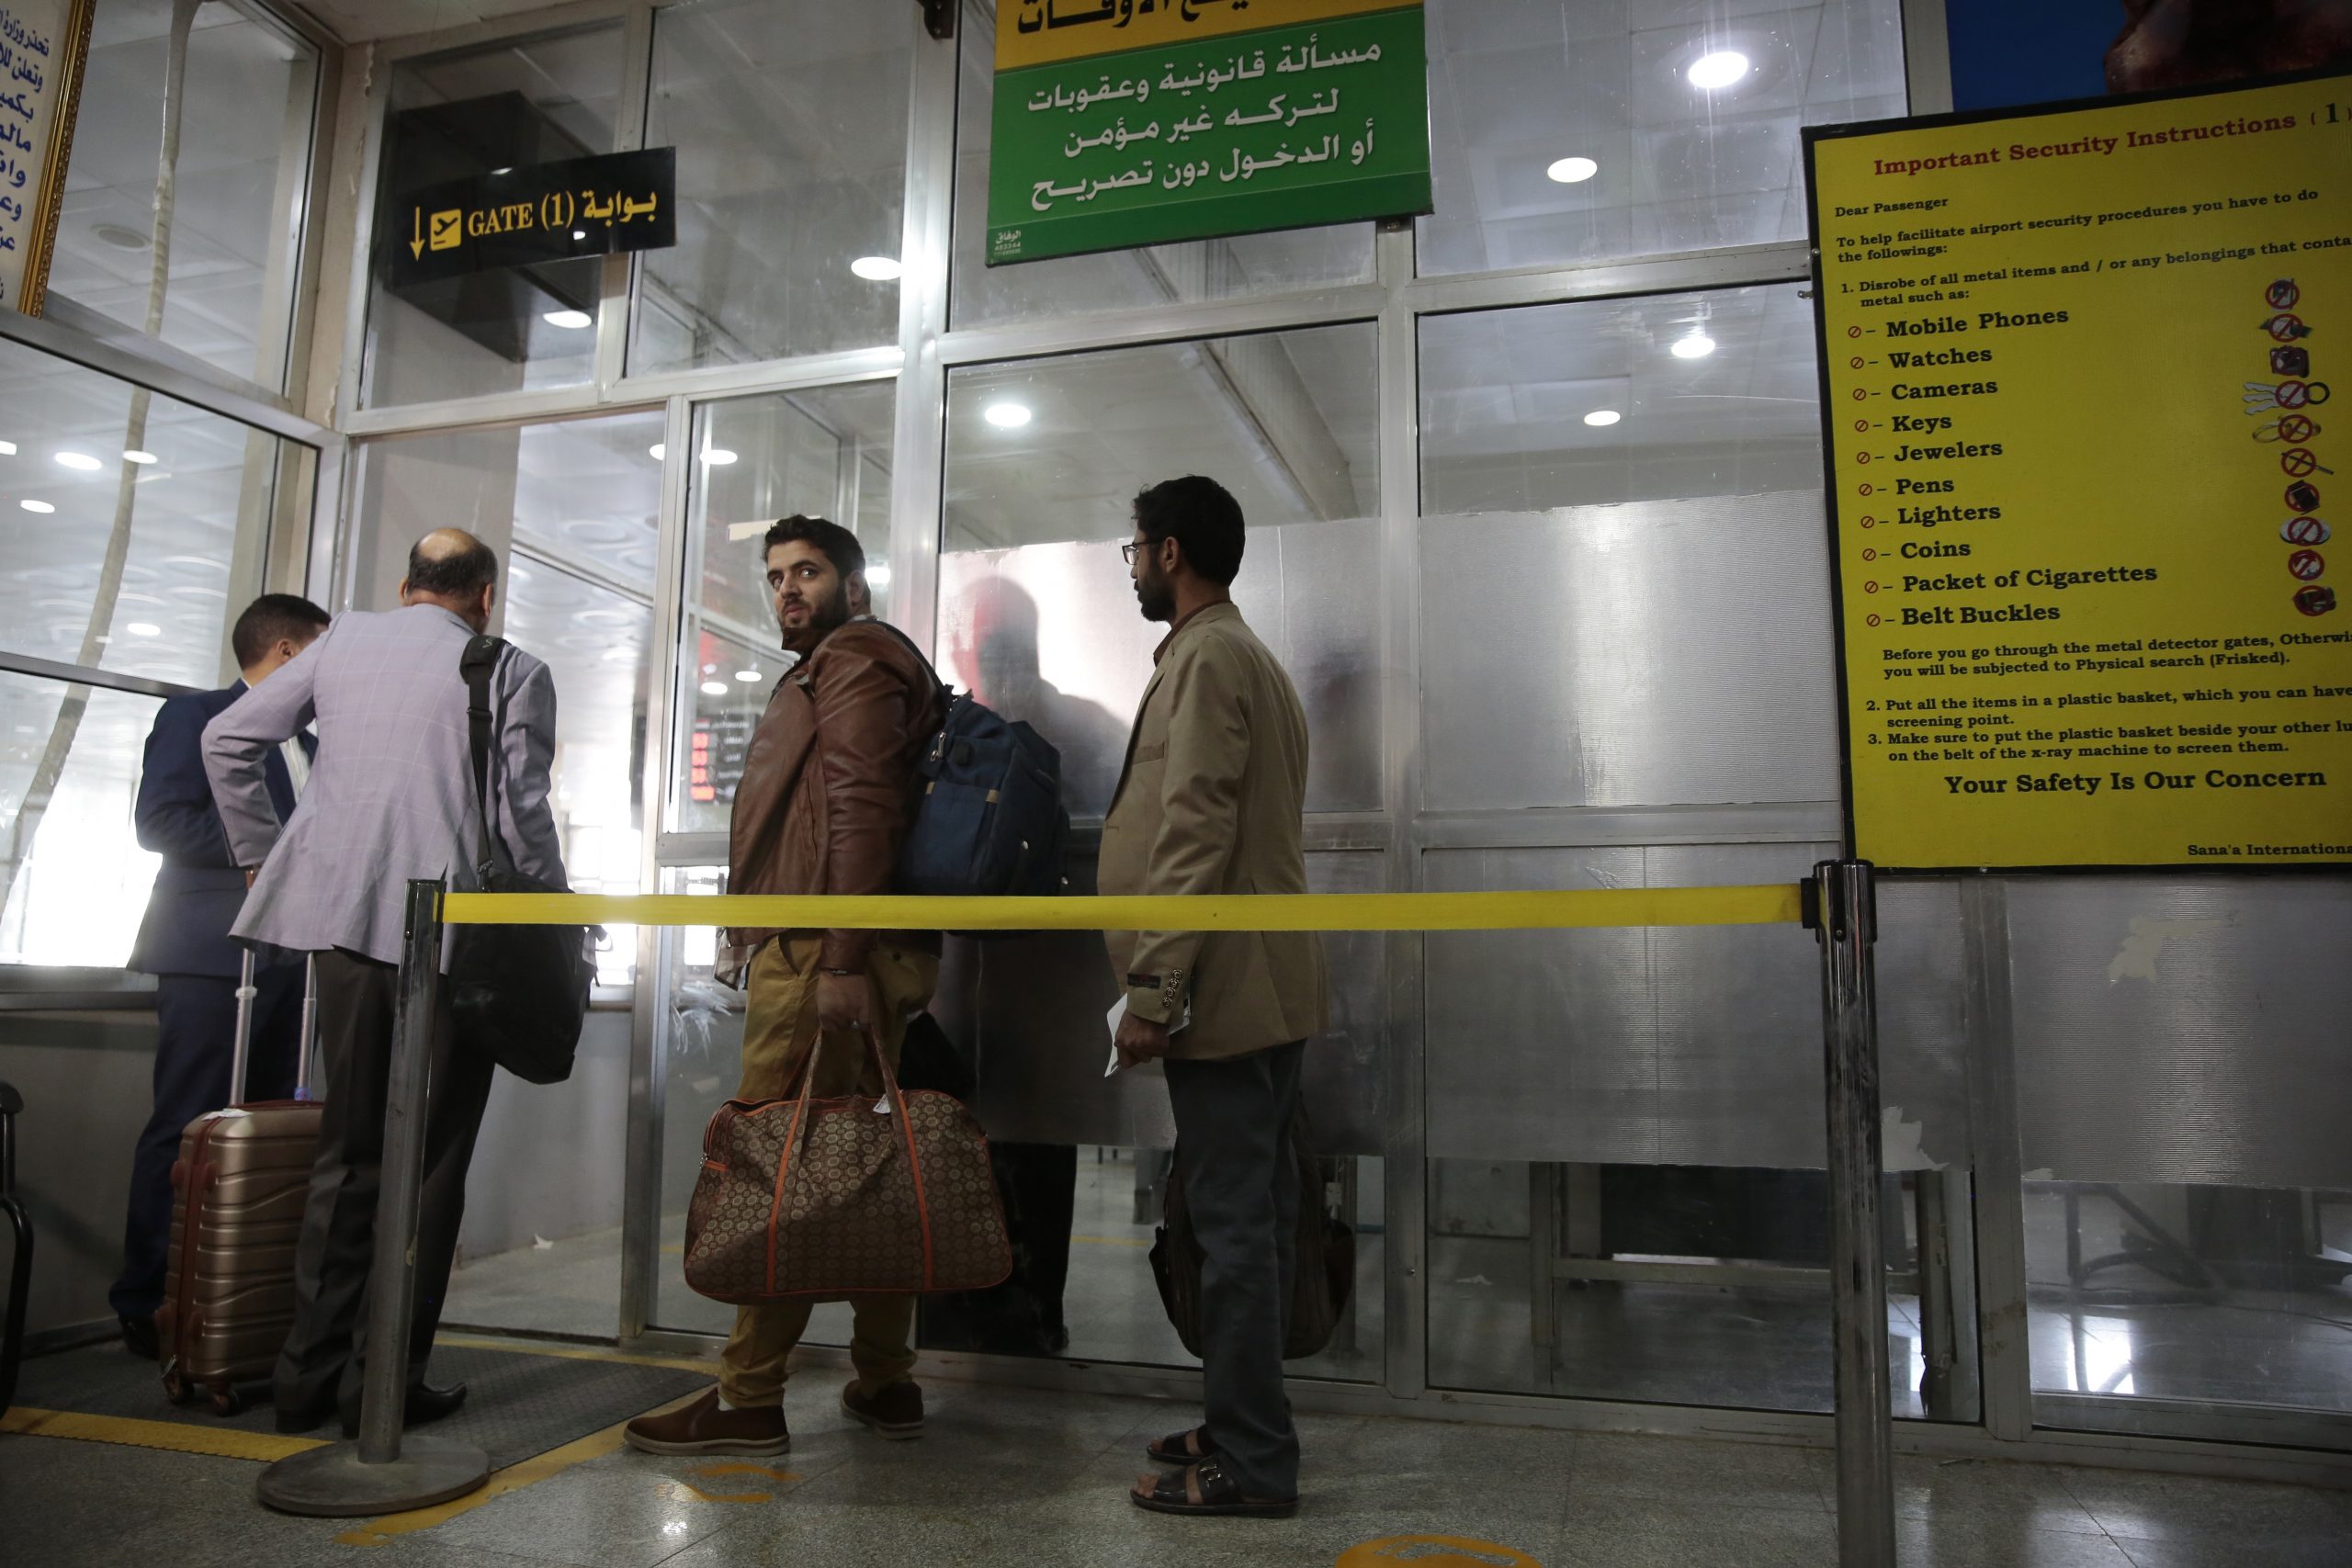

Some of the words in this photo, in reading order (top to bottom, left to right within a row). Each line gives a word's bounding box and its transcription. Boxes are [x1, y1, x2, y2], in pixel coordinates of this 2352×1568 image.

[1275, 32, 1383, 73] مسألة
[1158, 49, 1266, 96] قانونية
[1027, 74, 1150, 113] وعقوبات
[1224, 87, 1340, 127] لتركه
[1166, 104, 1215, 143] غير
[1063, 117, 1161, 158] مؤمن
[1350, 118, 1375, 164] أو
[1873, 147, 2001, 176] Important
[2008, 136, 2119, 161] Security
[2126, 116, 2297, 148] Instructions
[1219, 134, 1340, 183] الدخول
[1031, 159, 1154, 211] تصريح
[1161, 159, 1210, 190] دون
[468, 202, 534, 237] GATE
[540, 191, 576, 231] (1)
[582, 189, 659, 228] بوابة
[1834, 206, 1870, 218] Dear
[1872, 197, 1949, 214] Passenger
[1836, 236, 1856, 248] To
[1859, 232, 1893, 246] help
[1896, 227, 1966, 242] facilitate
[1970, 220, 2024, 236] airport
[2027, 214, 2093, 230] security
[2097, 205, 2188, 226] procedures
[2191, 201, 2223, 216] you
[2227, 197, 2268, 209] have
[2273, 193, 2292, 204] to
[2297, 188, 2319, 201] do
[1837, 252, 1862, 264] the
[1867, 245, 1948, 261] followings:
[1840, 282, 1855, 294] 1.
[1859, 277, 1916, 292] Disrobe
[1920, 274, 1938, 287] of
[1939, 272, 1960, 285] all
[1962, 268, 2008, 283] metal
[2011, 266, 2057, 279] items
[2060, 260, 2091, 275] and
[2109, 260, 2128, 270] or
[2131, 256, 2162, 269] any
[2165, 247, 2256, 265] belongings
[2259, 241, 2298, 255] that
[1860, 293, 1905, 308] metal
[1907, 289, 1944, 303] such
[1948, 289, 1970, 300] as:
[1885, 315, 1968, 338] Mobile
[1977, 310, 2070, 330] Phones
[1887, 347, 1993, 369] Watches
[1891, 381, 1999, 400] Cameras
[1891, 414, 1952, 435] Keys
[1893, 440, 2004, 462] Jewelers
[1894, 478, 1955, 496] Pens
[1896, 504, 2002, 528] Lighters
[1900, 540, 1972, 559] Coins
[1902, 572, 1987, 592] Packet
[1994, 570, 2021, 588] of
[2026, 566, 2158, 591] Cigarettes
[1900, 605, 1955, 626] Belt
[1959, 603, 2062, 624] Buckles
[1882, 648, 1933, 660] Before
[1937, 649, 1967, 662] you
[1971, 648, 1990, 661] go
[1994, 642, 2059, 658] through
[2063, 641, 2091, 654] the
[2095, 638, 2143, 653] metal
[2147, 637, 2219, 651] detector
[2223, 636, 2275, 651] gates,
[1883, 668, 1914, 681] you
[1917, 663, 1946, 677] will
[1949, 663, 1968, 675] be
[1973, 660, 2050, 677] subjected
[2052, 660, 2071, 671] to
[2075, 656, 2145, 673] Physical
[2149, 654, 2206, 668] search
[2210, 650, 2290, 669] (Frisked).
[1865, 699, 1881, 712] 2.
[1884, 699, 1914, 711] Put
[1917, 697, 1938, 710] all
[1940, 697, 1968, 710] the
[1972, 696, 2018, 709] items
[2021, 694, 2040, 707] in
[2042, 696, 2053, 706] a
[2057, 692, 2113, 709] plastic
[2116, 691, 2178, 705] basket,
[2181, 688, 2234, 702] which
[2238, 690, 2272, 704] you
[2276, 688, 2309, 699] can
[2312, 684, 2352, 697] have
[1867, 733, 1883, 745] 3.
[1886, 732, 1929, 745] Make
[1933, 734, 1968, 744] sure
[1972, 731, 1990, 743] to
[1994, 730, 2022, 745] put
[2026, 728, 2053, 741] the
[2058, 727, 2114, 743] plastic
[2117, 725, 2174, 739] basket
[2177, 723, 2233, 737] beside
[2236, 725, 2279, 739] your
[2282, 720, 2332, 734] other
[1886, 715, 1963, 729] screening
[1967, 713, 2015, 729] point.
[1888, 752, 1909, 761] on
[1912, 749, 1939, 761] the
[1942, 748, 1975, 761] belt
[1979, 747, 1997, 760] of
[1999, 747, 2027, 760] the
[2030, 748, 2074, 761] x-ray
[2077, 744, 2149, 757] machine
[2153, 743, 2172, 755] to
[2177, 744, 2233, 754] screen
[2237, 740, 2290, 753] them.
[1943, 775, 2008, 795] Your
[2016, 773, 2102, 796] Safety
[2109, 772, 2136, 791] Is
[2143, 771, 2197, 790] Our
[2204, 769, 2328, 788] Concern
[2187, 844, 2243, 856] Sana'a
